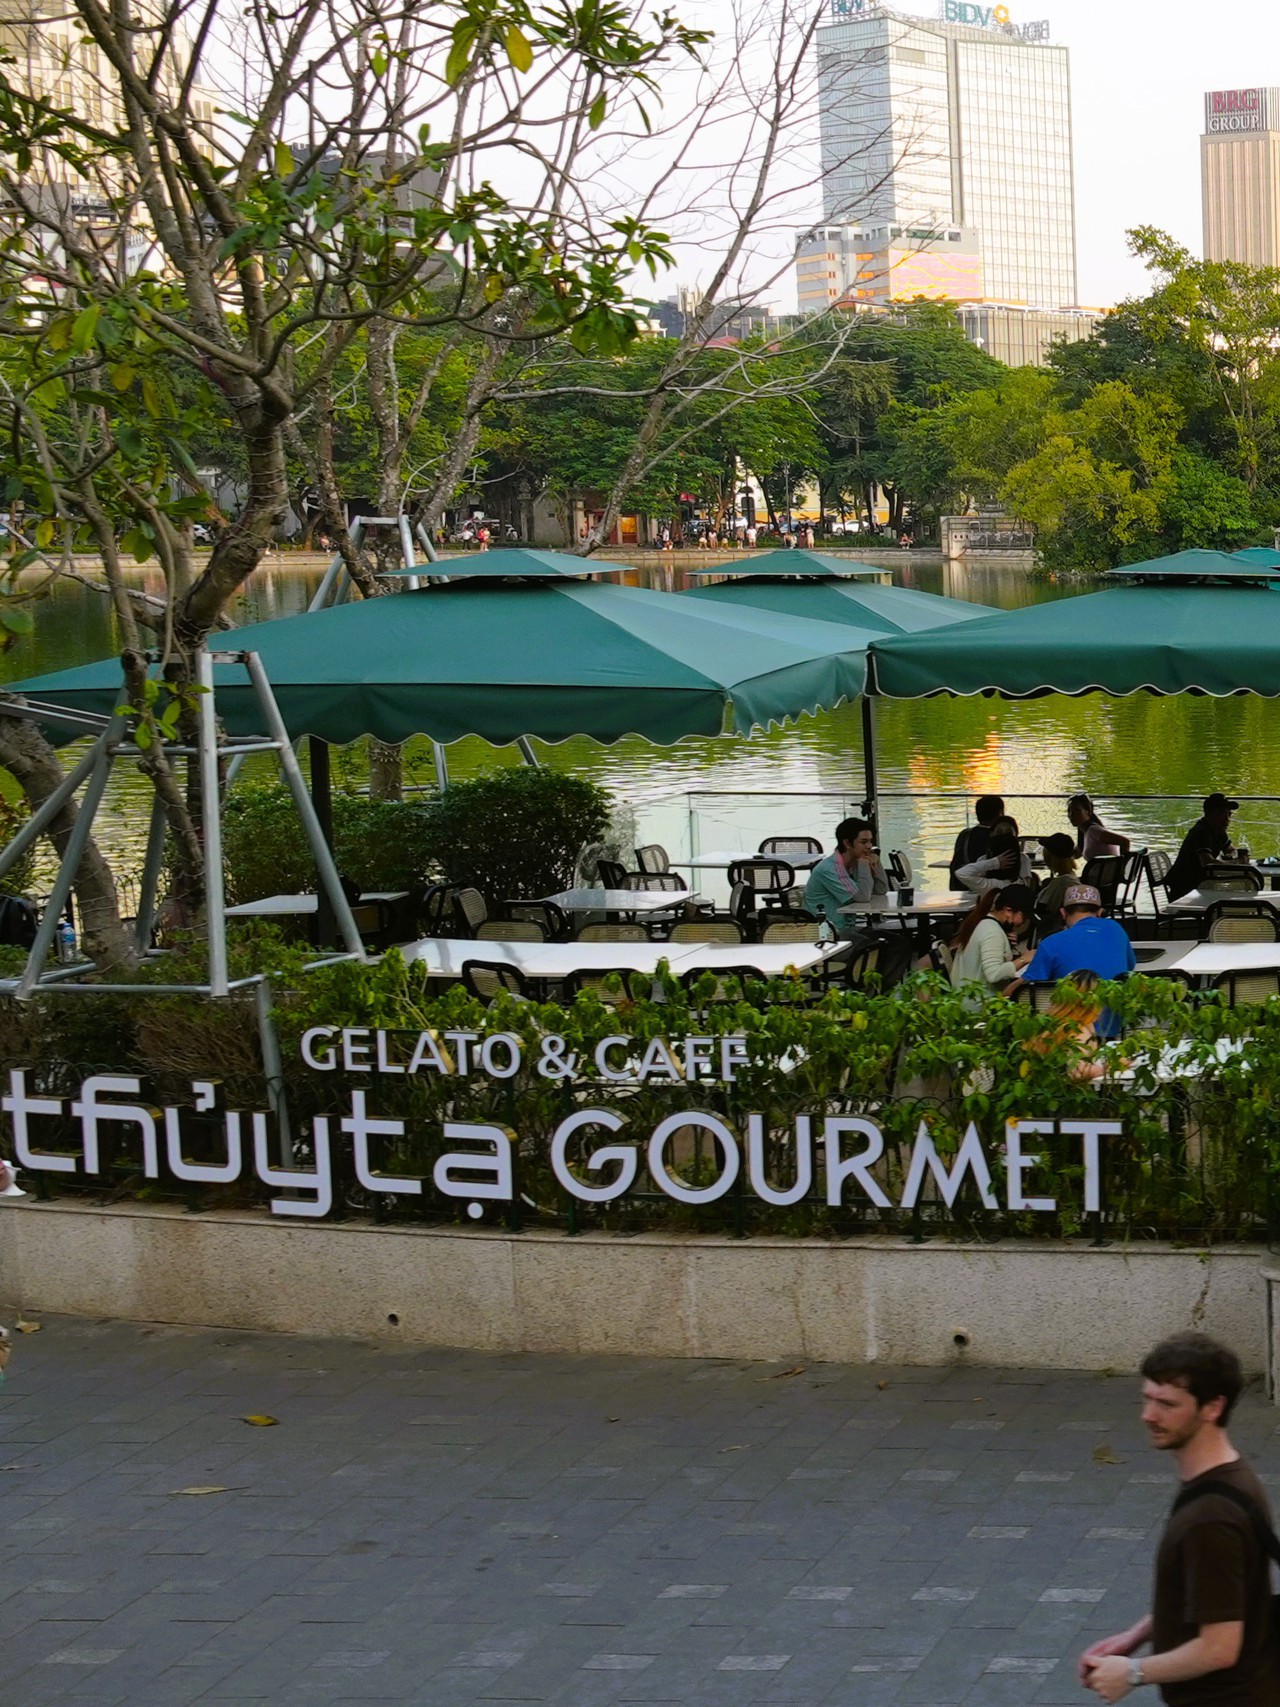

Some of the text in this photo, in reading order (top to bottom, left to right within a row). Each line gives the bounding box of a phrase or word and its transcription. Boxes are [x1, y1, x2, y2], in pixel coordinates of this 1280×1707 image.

[945, 1, 993, 26] BIDV
[1212, 89, 1258, 112] BRG
[1209, 114, 1259, 131] GROUP
[301, 1027, 522, 1079] GELATO
[537, 1034, 578, 1080] &
[551, 1108, 1122, 1212] GOURMET
